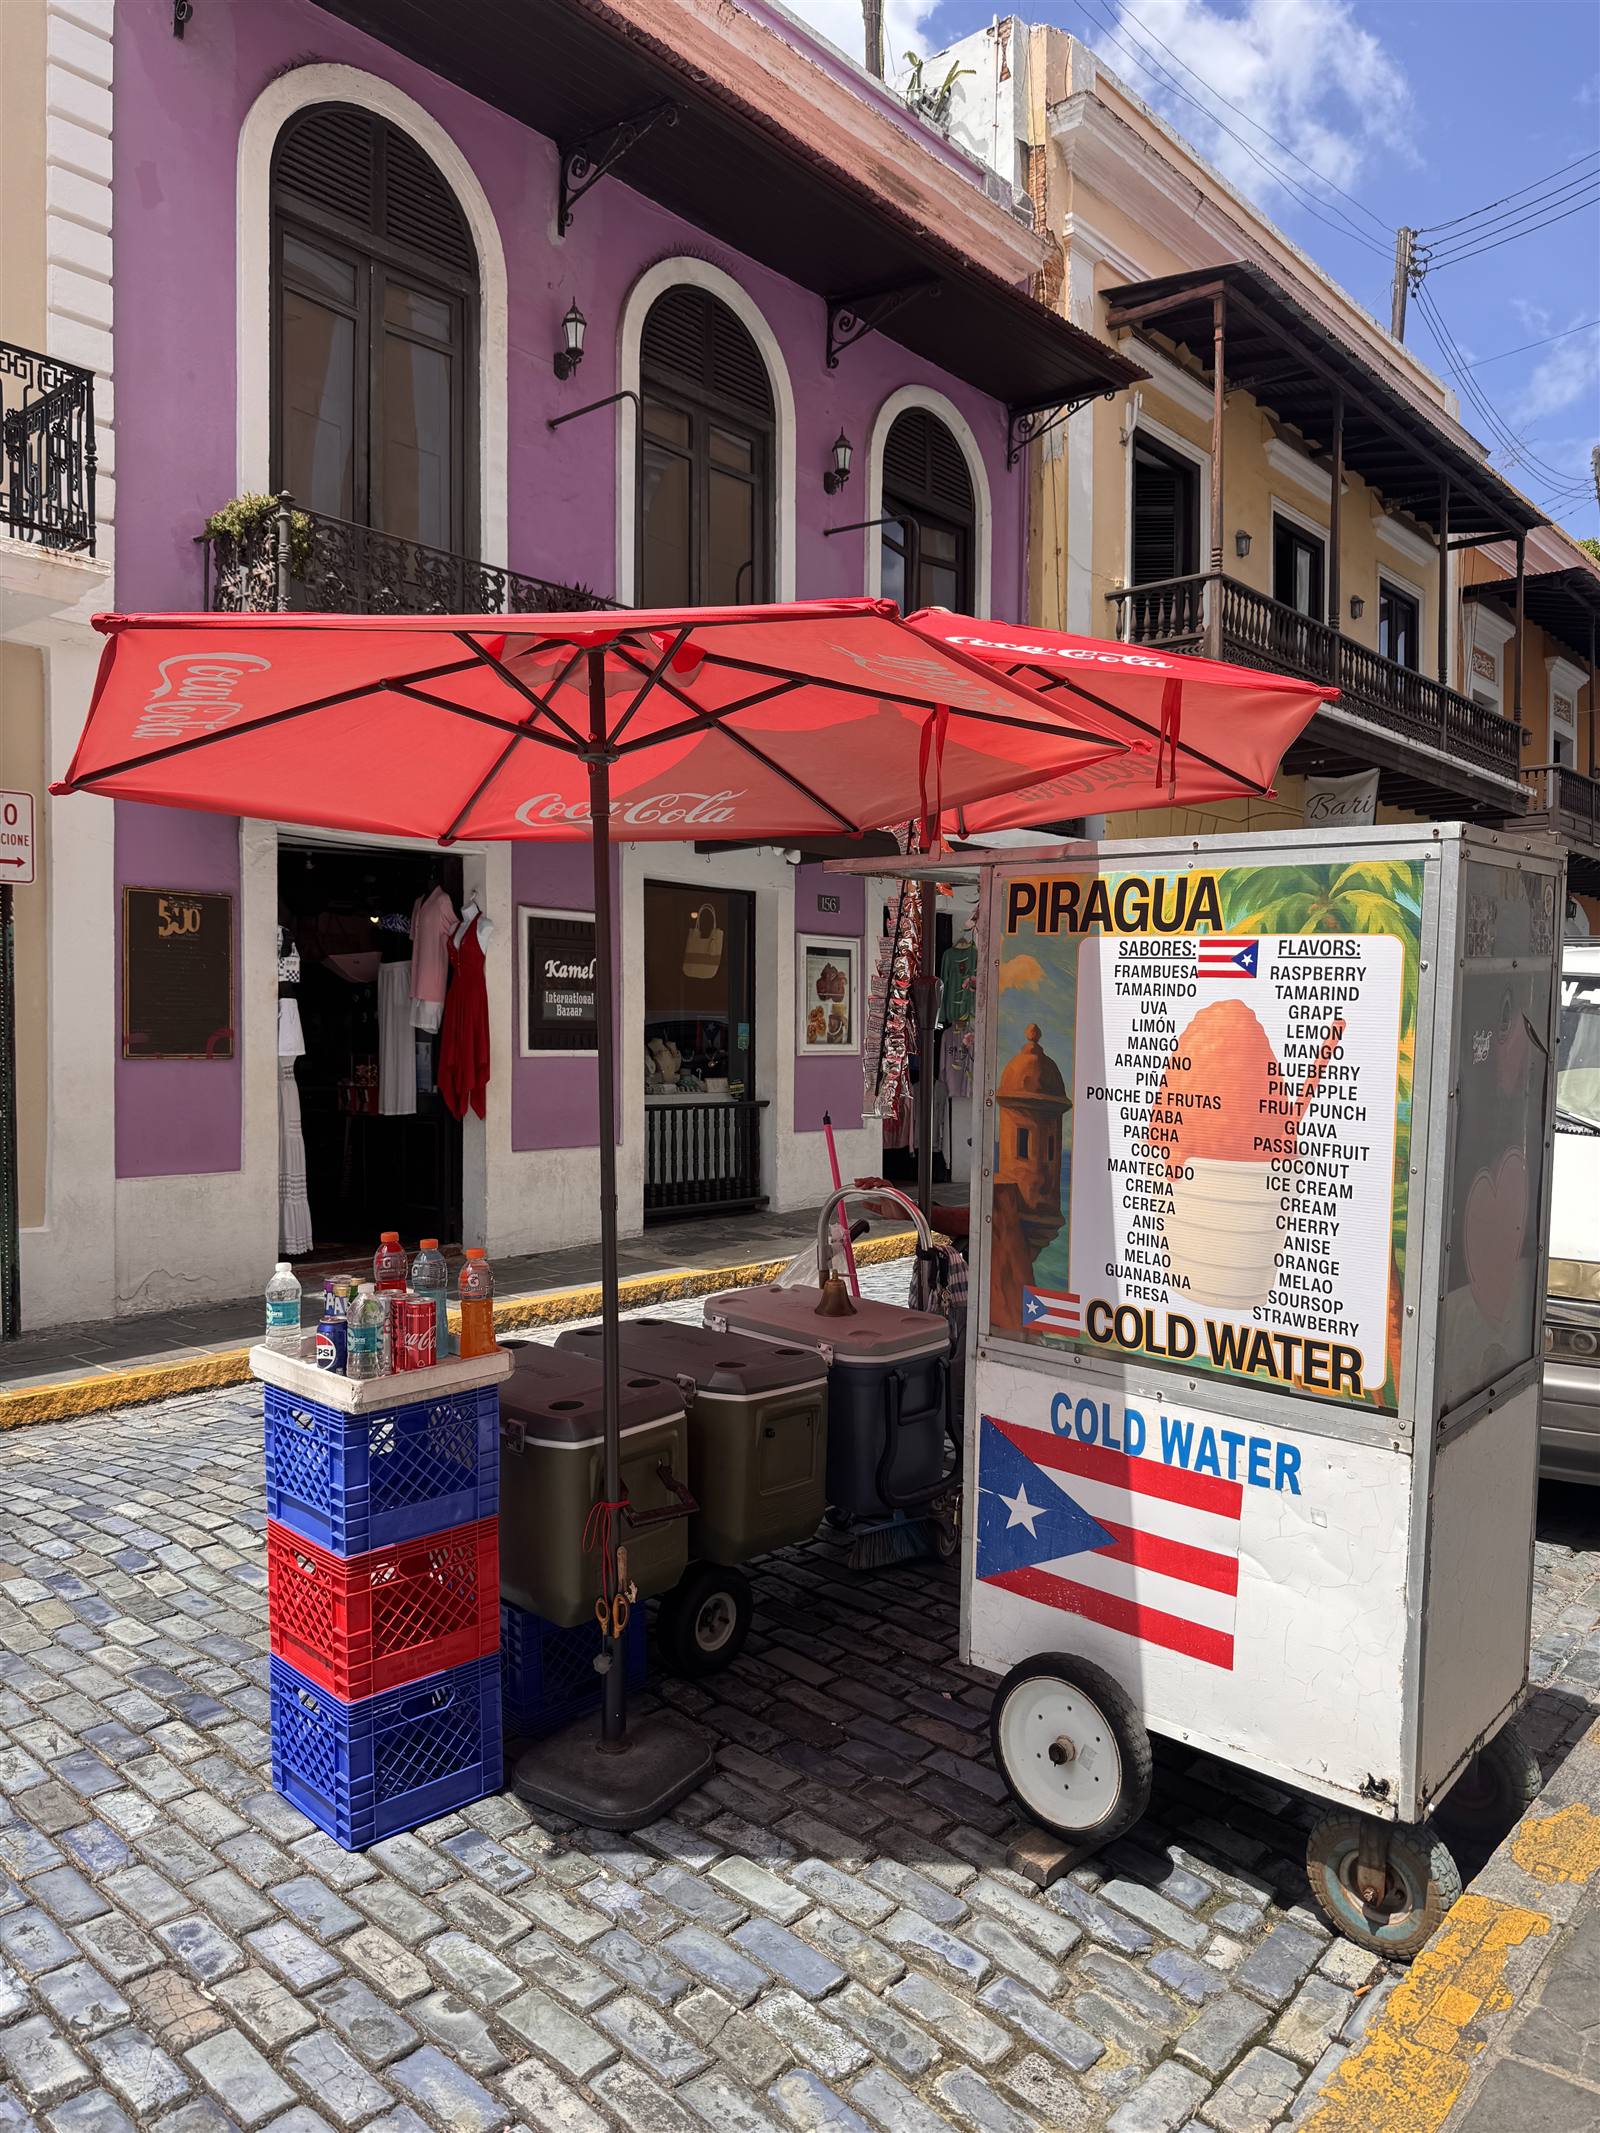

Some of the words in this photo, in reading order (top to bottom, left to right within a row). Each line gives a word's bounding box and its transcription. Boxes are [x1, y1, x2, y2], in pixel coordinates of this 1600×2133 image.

[1306, 792, 1374, 820] Bari
[821, 896, 837, 911] 156
[1008, 876, 1222, 934] PIRAGUA
[1119, 940, 1197, 959] SABORES:
[1278, 940, 1361, 959] FLAVORS:
[544, 958, 597, 980] Kamel
[1114, 964, 1199, 980] FRAMBUESA
[1270, 965, 1367, 982] RASPBERRY
[545, 991, 594, 1005] International
[1114, 982, 1197, 997] TAMARINDO
[1275, 985, 1360, 1001] TAMARIND
[556, 1004, 583, 1017] Bazaar
[1140, 1001, 1167, 1015] UVA
[1288, 1005, 1343, 1021] GRAPE
[1131, 1017, 1176, 1034] LIMÓN
[1286, 1025, 1343, 1041] LEMON
[1127, 1034, 1179, 1052] MANGÓ
[1283, 1044, 1345, 1060] MANGO
[1114, 1054, 1192, 1071] ARANDANO
[1267, 1062, 1361, 1081] BLUEBERRY
[1135, 1070, 1168, 1088] PIÑA
[1086, 1087, 1142, 1105] PONCHE
[1146, 1091, 1164, 1106] DE
[1167, 1093, 1222, 1111] FRUTAS
[1268, 1081, 1358, 1101] PINEAPPLE
[1120, 1107, 1184, 1126] GUAYABA
[1258, 1099, 1304, 1117] FRUIT
[1309, 1103, 1367, 1122] PUNCH
[1123, 1125, 1179, 1143] PARCHA
[1284, 1121, 1338, 1139] GUAVA
[1131, 1143, 1170, 1160] COCO
[1253, 1136, 1370, 1162] PASSIONFRUIT
[1107, 1158, 1195, 1181] MANTECADO
[1270, 1157, 1349, 1179] COCONUT
[1125, 1178, 1174, 1197] CREMA
[1266, 1176, 1291, 1193] ICE
[1296, 1178, 1353, 1199] CREAM
[1122, 1195, 1176, 1215] CEREZA
[1280, 1197, 1337, 1217] CREAM
[1132, 1214, 1165, 1231] ANIS
[1275, 1215, 1340, 1236] CHERRY
[1126, 1231, 1170, 1250] CHINA
[1283, 1235, 1331, 1255] ANISE
[1124, 1248, 1171, 1268] MELAO
[1273, 1253, 1340, 1276] ORANGE
[1105, 1262, 1191, 1290] GUANABANA
[1279, 1273, 1333, 1294] MELAO
[1125, 1284, 1169, 1304] FRESA
[1267, 1289, 1344, 1314] SOURSOP
[1252, 1306, 1359, 1337] STRAWBERRY
[1086, 1299, 1197, 1360] COLD
[1205, 1320, 1365, 1398] WATER
[1050, 1392, 1146, 1457] COLD
[1160, 1416, 1301, 1495] WATER
